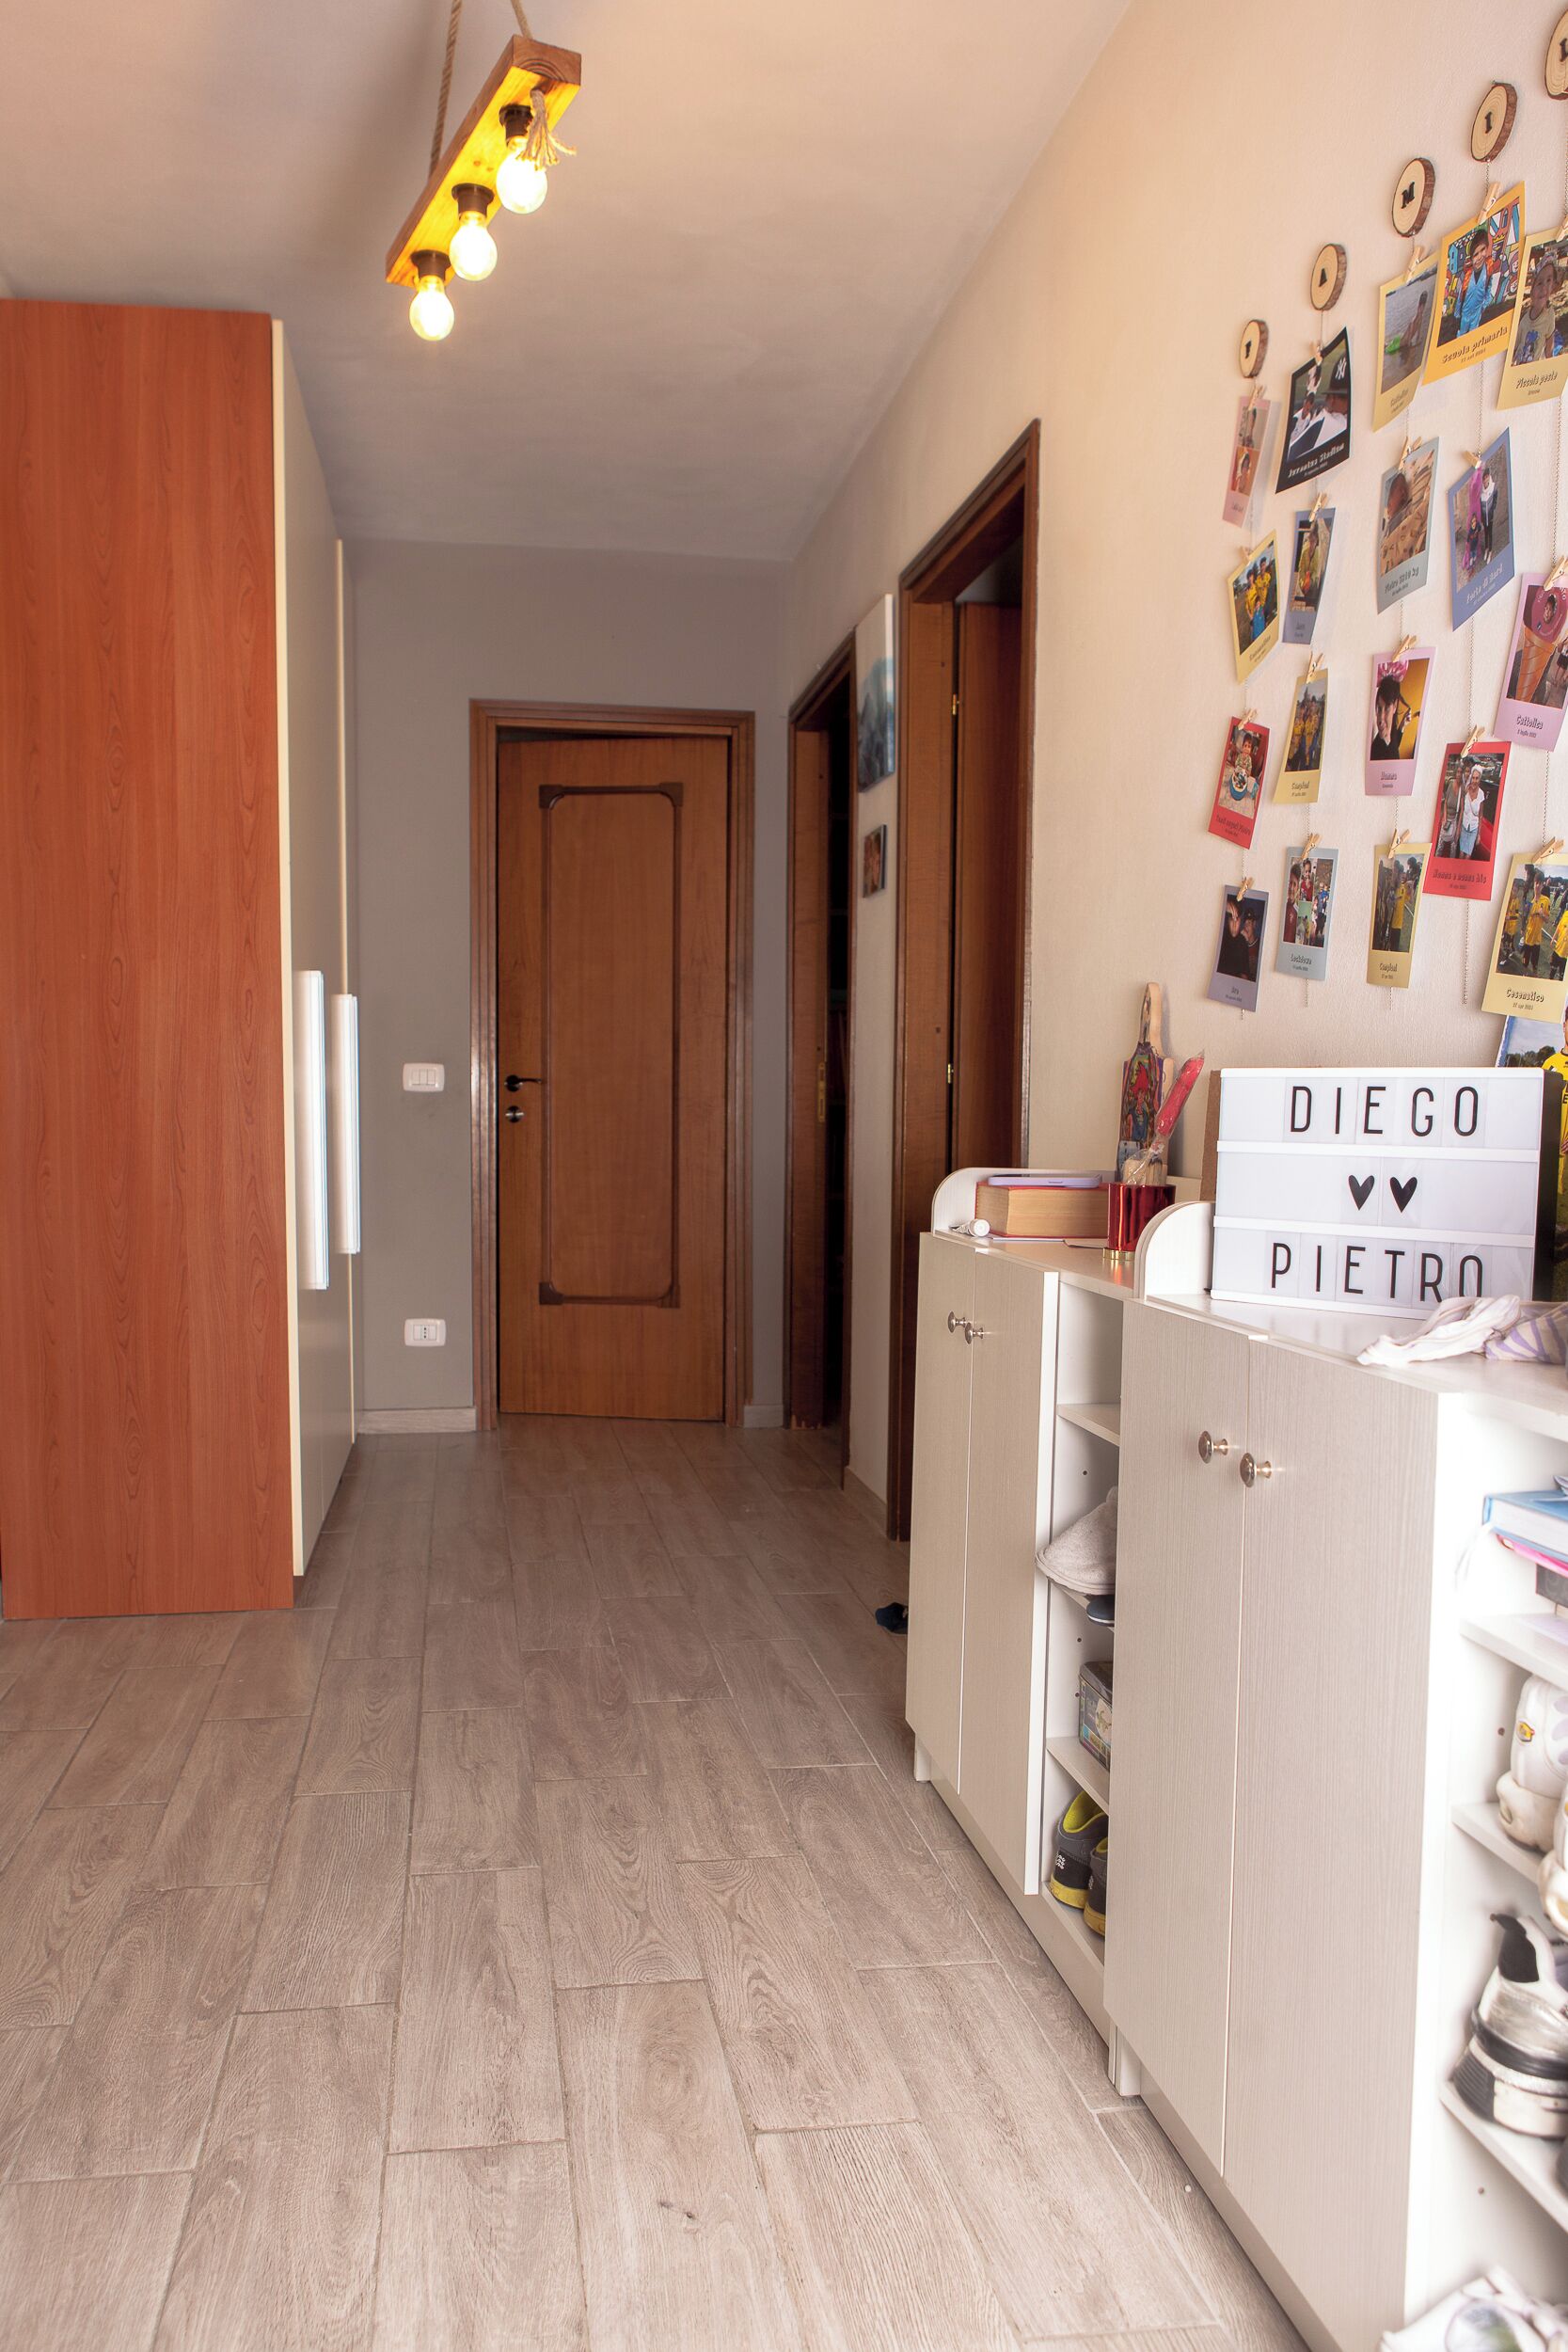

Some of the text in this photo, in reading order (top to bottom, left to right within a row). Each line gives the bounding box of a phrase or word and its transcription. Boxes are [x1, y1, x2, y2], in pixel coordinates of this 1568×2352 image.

[1442, 326, 1508, 364] Scuola primaria
[1287, 458, 1318, 479] Juventus
[1319, 442, 1345, 463] Stadium
[1506, 989, 1544, 1003] Cesenatico
[1290, 1085, 1479, 1137] DIEGO
[1271, 1242, 1483, 1303] PIETRO
